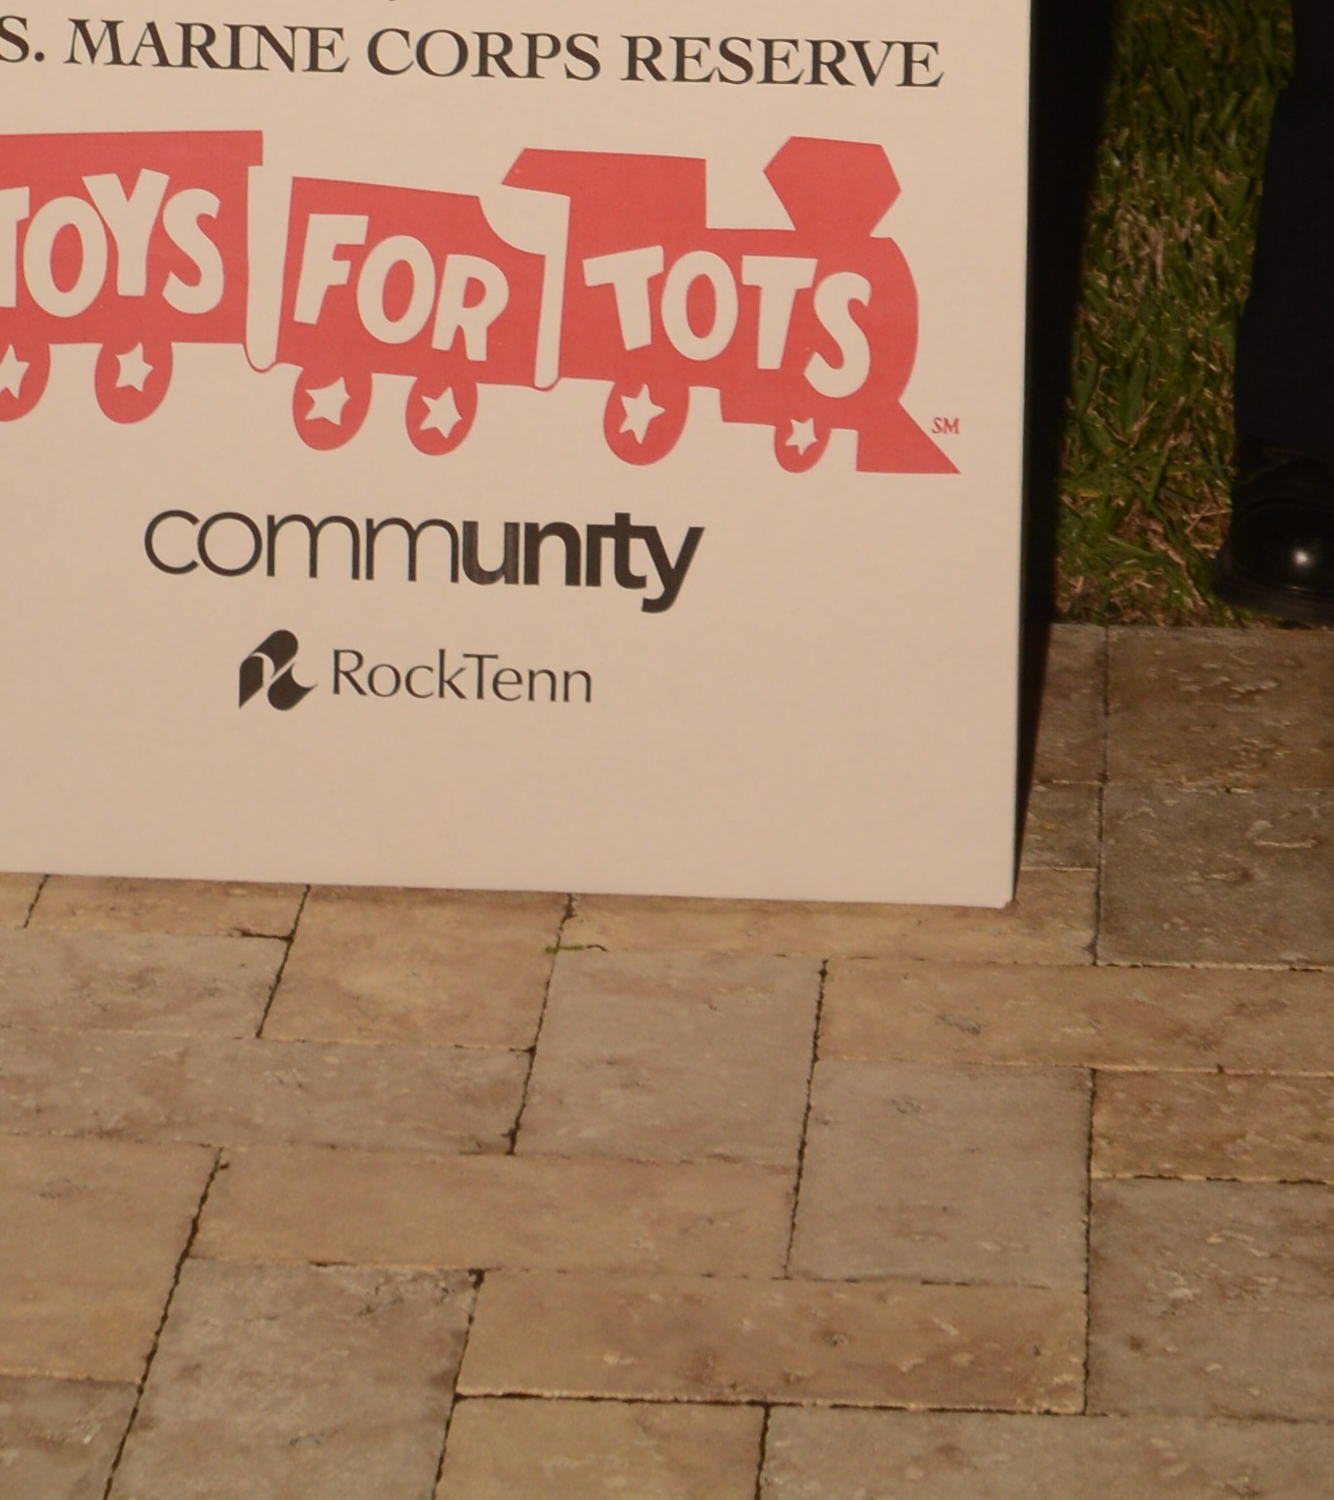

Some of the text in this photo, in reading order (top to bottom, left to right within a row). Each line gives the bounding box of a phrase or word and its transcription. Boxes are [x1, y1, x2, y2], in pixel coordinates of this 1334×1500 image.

[64, 18, 349, 73] MARINE
[367, 28, 601, 81] CORPS
[620, 35, 945, 88] RESERVE
[294, 213, 509, 361] FOR
[583, 250, 872, 399] TOTS
[144, 509, 705, 614] community
[332, 648, 593, 704] RockTenn
